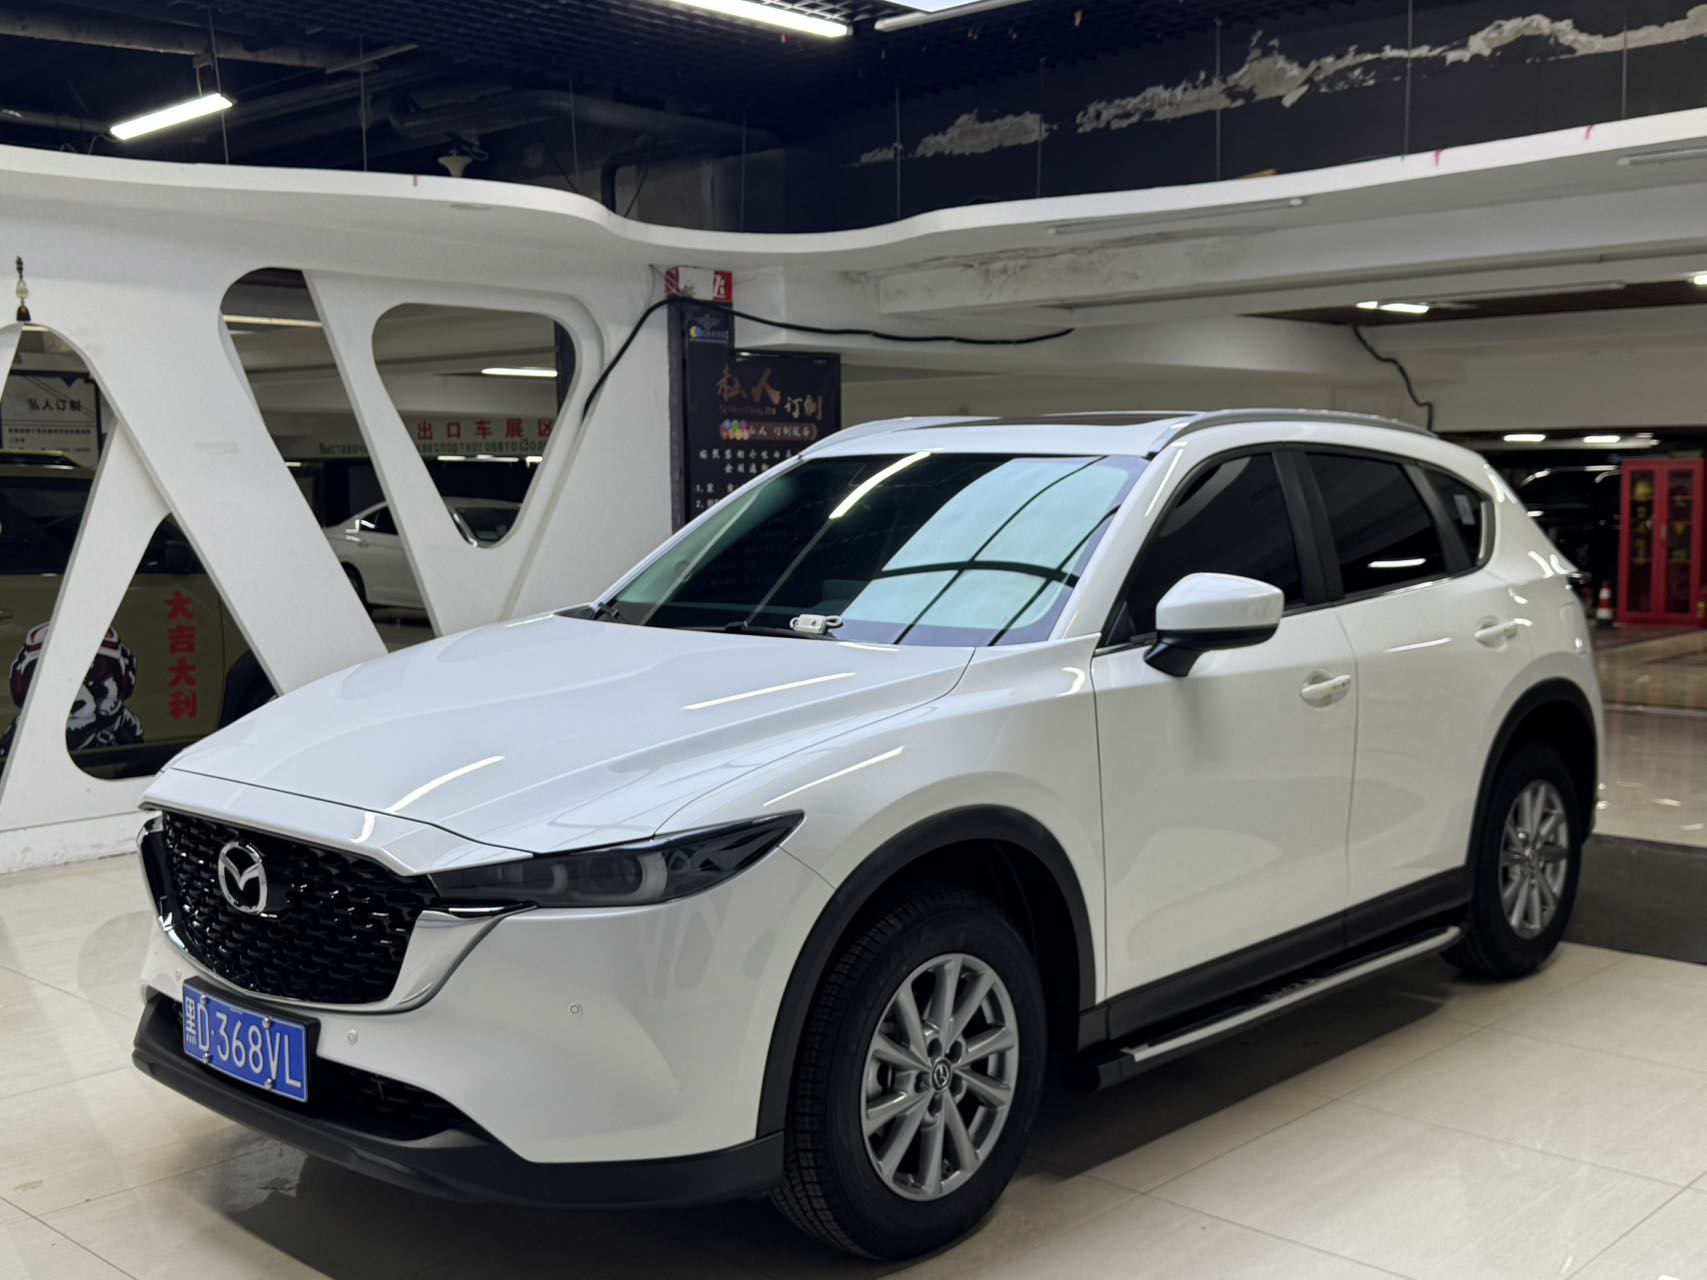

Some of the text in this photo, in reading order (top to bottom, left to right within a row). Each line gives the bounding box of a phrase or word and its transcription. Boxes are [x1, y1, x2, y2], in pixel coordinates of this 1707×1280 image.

[417, 418, 553, 440] 出口车展区
[166, 590, 199, 721] 大吉大利
